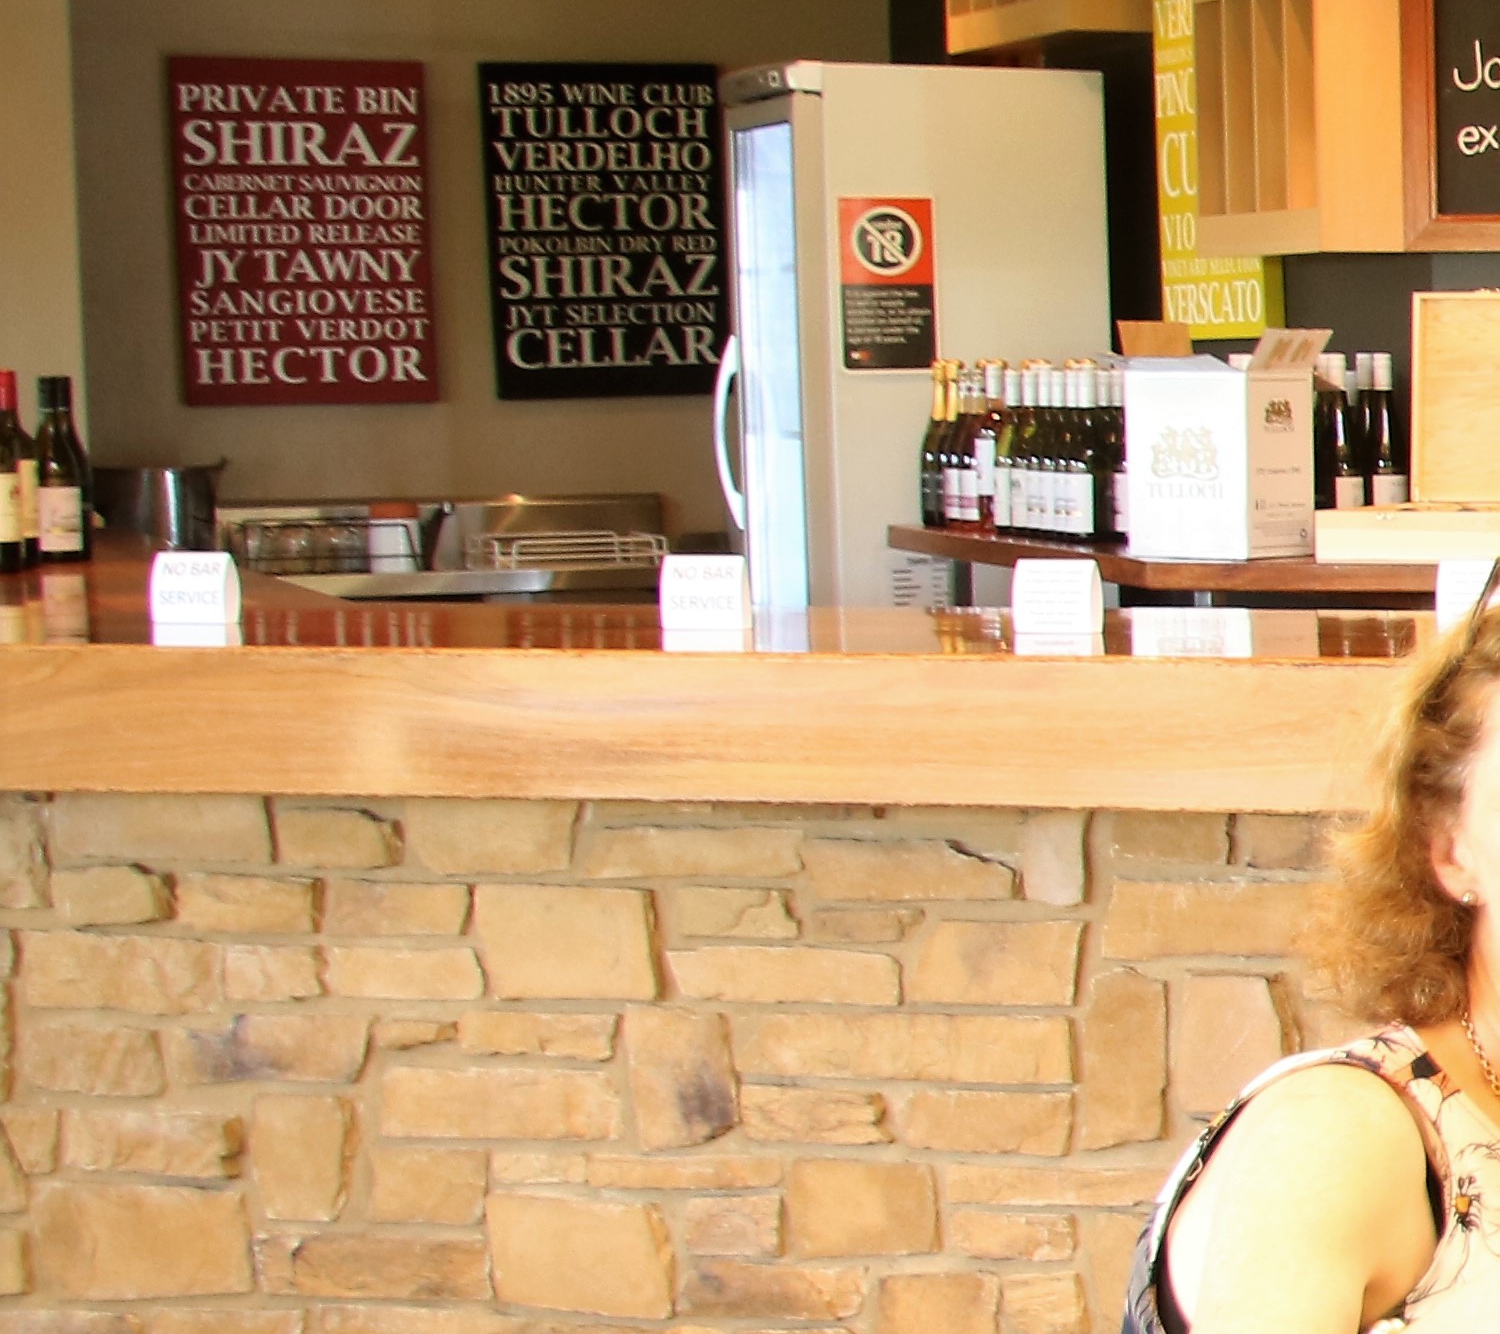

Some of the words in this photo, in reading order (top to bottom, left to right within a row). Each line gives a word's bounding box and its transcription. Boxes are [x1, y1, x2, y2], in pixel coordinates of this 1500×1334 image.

[177, 83, 345, 114] PRIVATE
[356, 85, 419, 115] BIN
[487, 82, 554, 104] 1895
[561, 83, 637, 104] WINE
[643, 83, 714, 106] CLUB
[491, 106, 709, 139] TULLOCH
[182, 119, 420, 166] SHIRAZ
[493, 141, 713, 172] VERDELHO
[184, 174, 297, 192] CABERNET
[300, 174, 423, 192] SAUVIGNON
[494, 174, 602, 192] HUNTER
[613, 174, 713, 192] VALLEY
[184, 194, 315, 220] CELLAR
[325, 194, 424, 220] DOOR
[496, 193, 718, 231] HECTOR
[189, 224, 300, 245] LIMITED
[309, 224, 422, 245] RELEASE
[499, 235, 613, 253] POKOLBIN
[619, 235, 667, 253] DRY
[671, 235, 718, 252] RED
[196, 249, 247, 289] JY
[253, 249, 422, 284] TAWNY
[500, 254, 719, 300] SHIRAZ
[190, 289, 427, 316] SANGIOVESE
[1164, 279, 1262, 324] VERSCATO
[505, 304, 560, 330] JYT
[565, 302, 716, 325] SELECTION
[190, 319, 285, 342] PETIT
[296, 318, 430, 341] VERDOT
[506, 326, 721, 369] CELLAR
[195, 346, 428, 385] HECTOR
[162, 562, 187, 576] NO
[190, 562, 221, 576] BAR
[672, 566, 697, 580] NO
[702, 566, 735, 580] BAR
[159, 590, 219, 605] SERVICE
[670, 595, 735, 610] SERVICE
